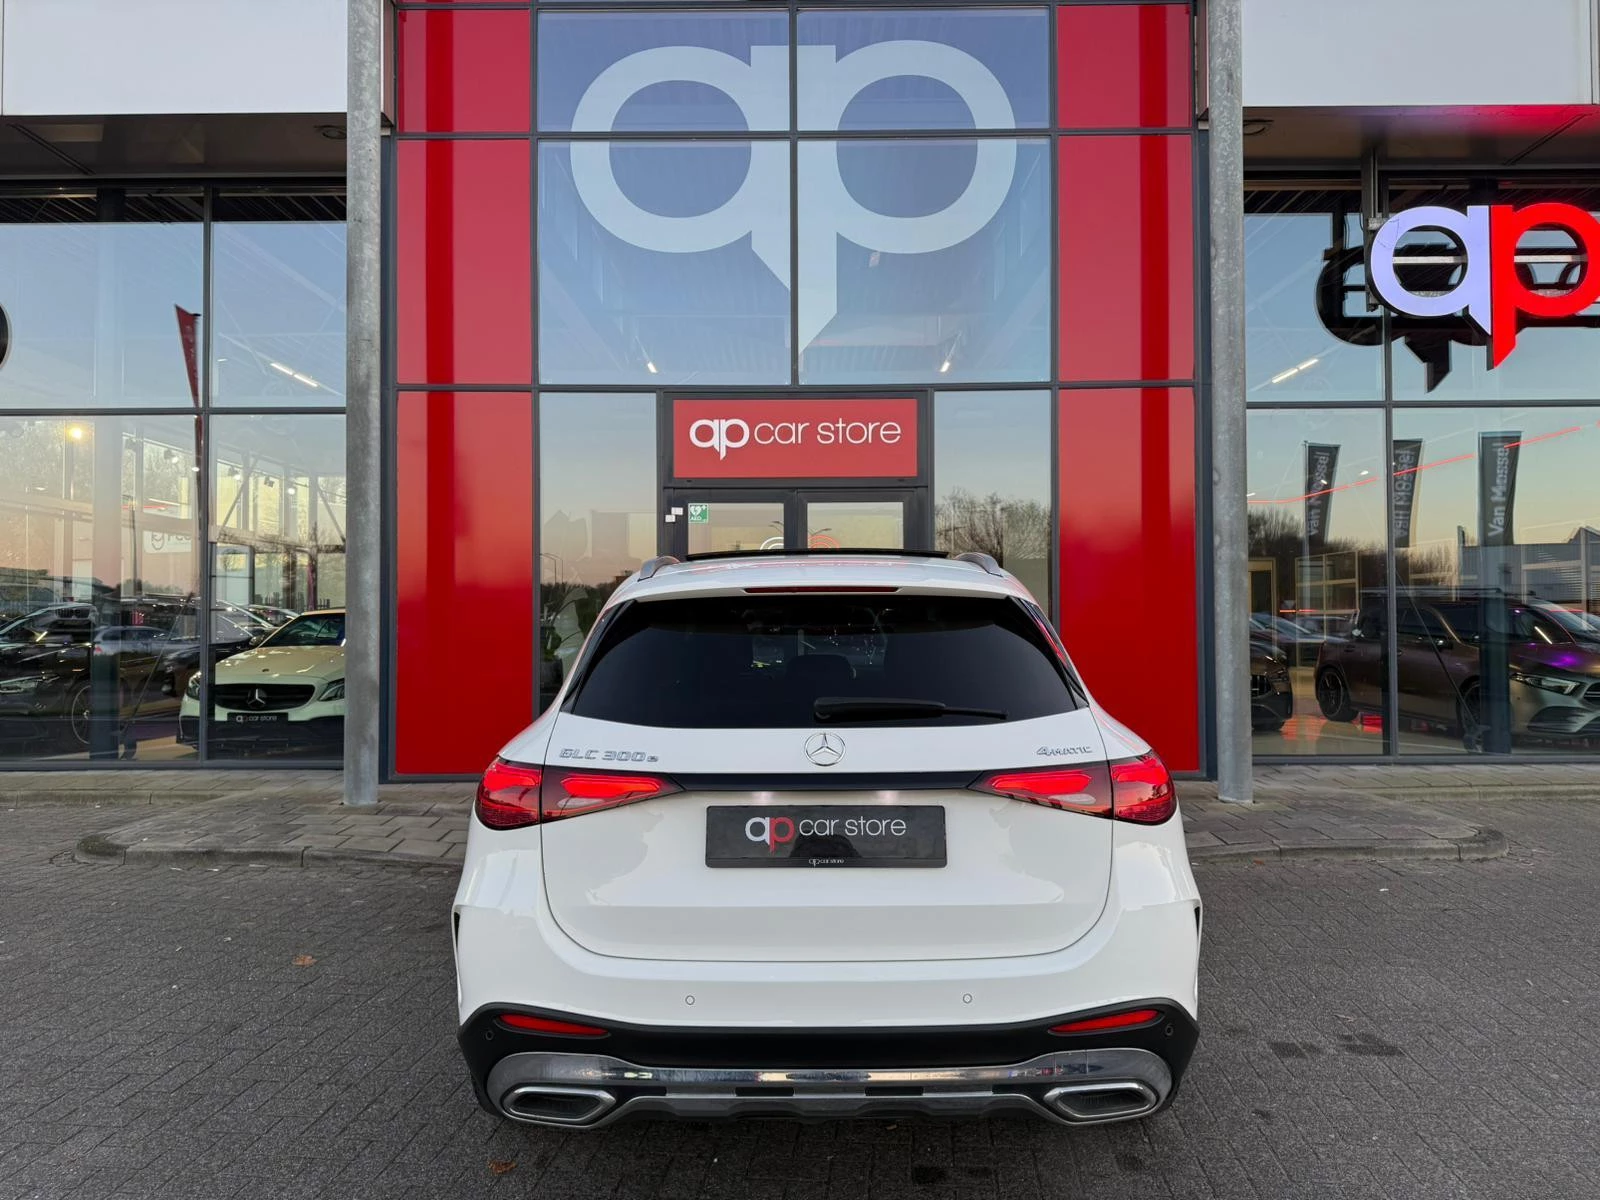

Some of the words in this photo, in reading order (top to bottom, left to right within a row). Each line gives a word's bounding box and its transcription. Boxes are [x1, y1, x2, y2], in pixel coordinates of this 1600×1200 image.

[689, 418, 750, 461] ap
[754, 422, 810, 445] car
[816, 417, 902, 445] store
[1488, 506, 1505, 536] Van
[559, 748, 599, 760] GLC
[1036, 746, 1093, 756] 4MATIC
[744, 816, 796, 854] ap
[800, 817, 840, 837] car
[844, 815, 907, 837] store
